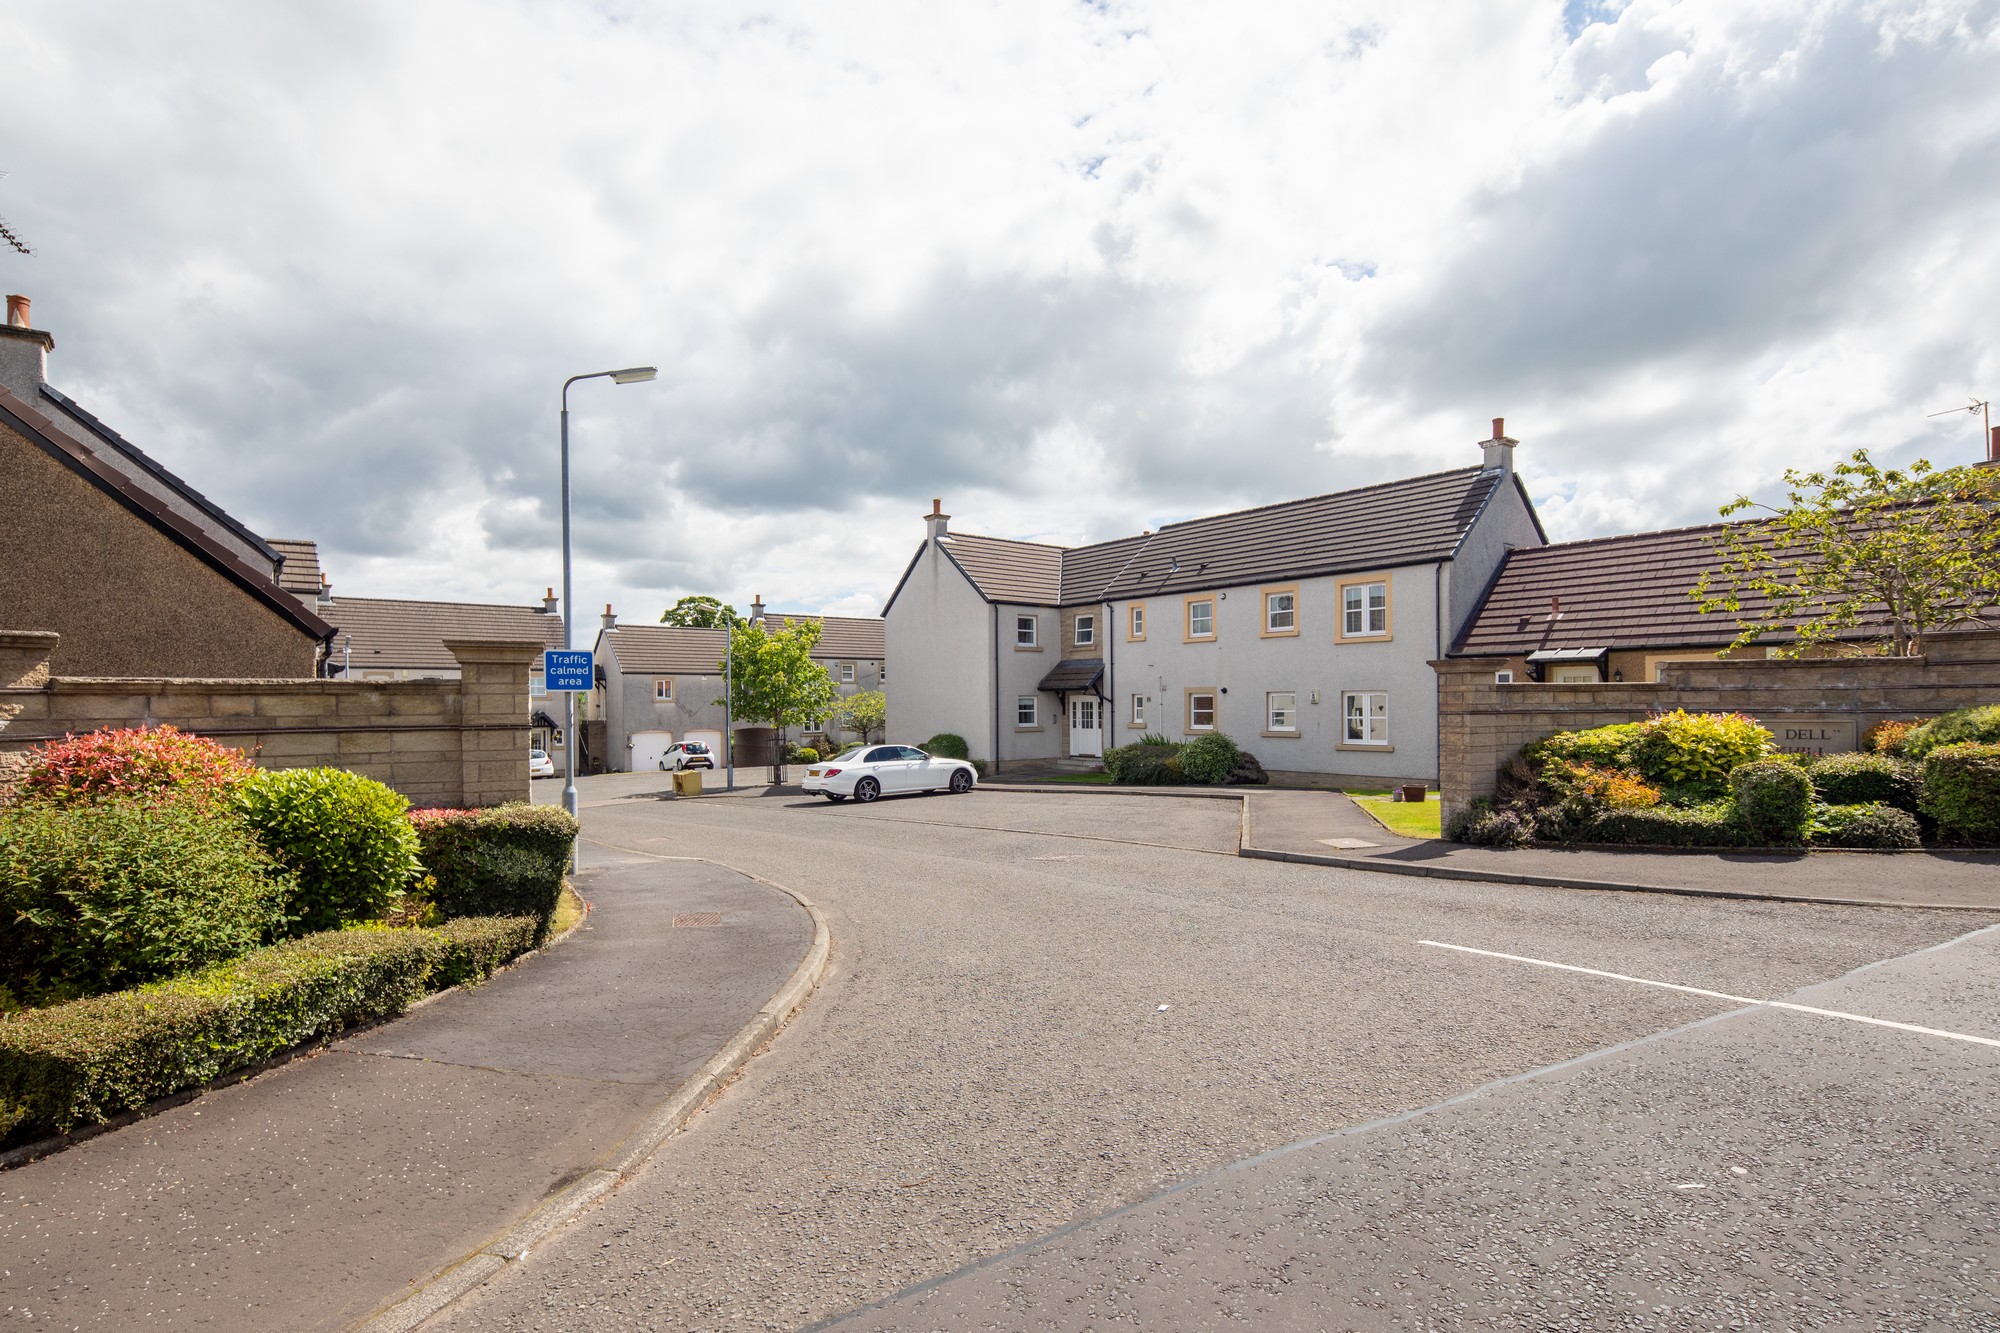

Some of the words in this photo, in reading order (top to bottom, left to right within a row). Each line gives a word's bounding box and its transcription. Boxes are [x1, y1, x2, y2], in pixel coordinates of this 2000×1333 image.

[552, 654, 588, 664] Traffic
[550, 666, 589, 675] calmed
[558, 678, 582, 686] area
